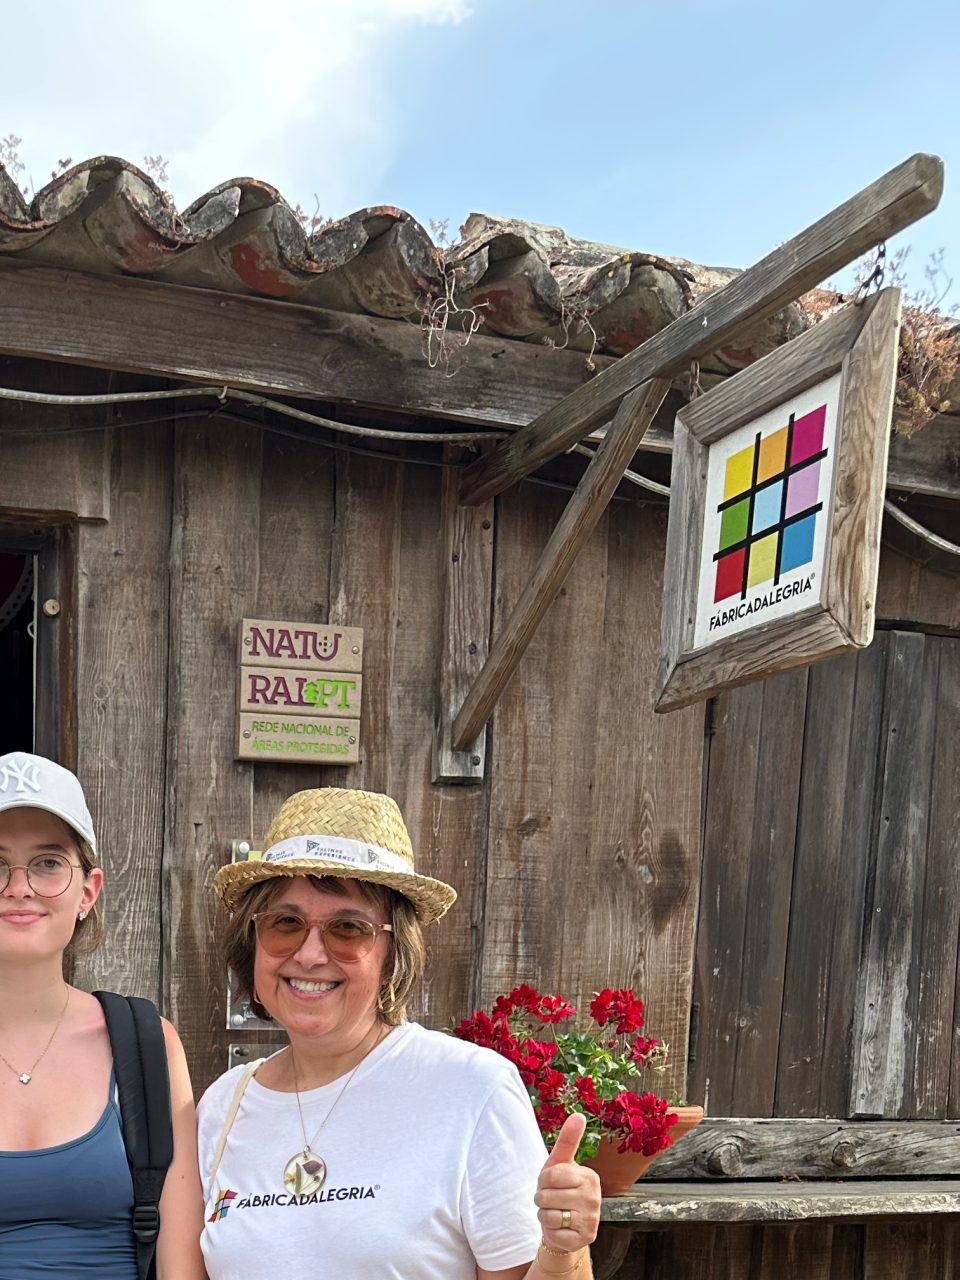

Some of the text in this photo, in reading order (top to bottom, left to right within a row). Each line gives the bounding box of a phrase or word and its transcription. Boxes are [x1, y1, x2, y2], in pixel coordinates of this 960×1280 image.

[249, 627, 342, 661] NATU
[252, 721, 349, 736] REDE NACIONAL DE
[251, 736, 349, 754] ÁREAS PROTEGIDAS
[314, 852, 355, 862] EXPERIENCE
